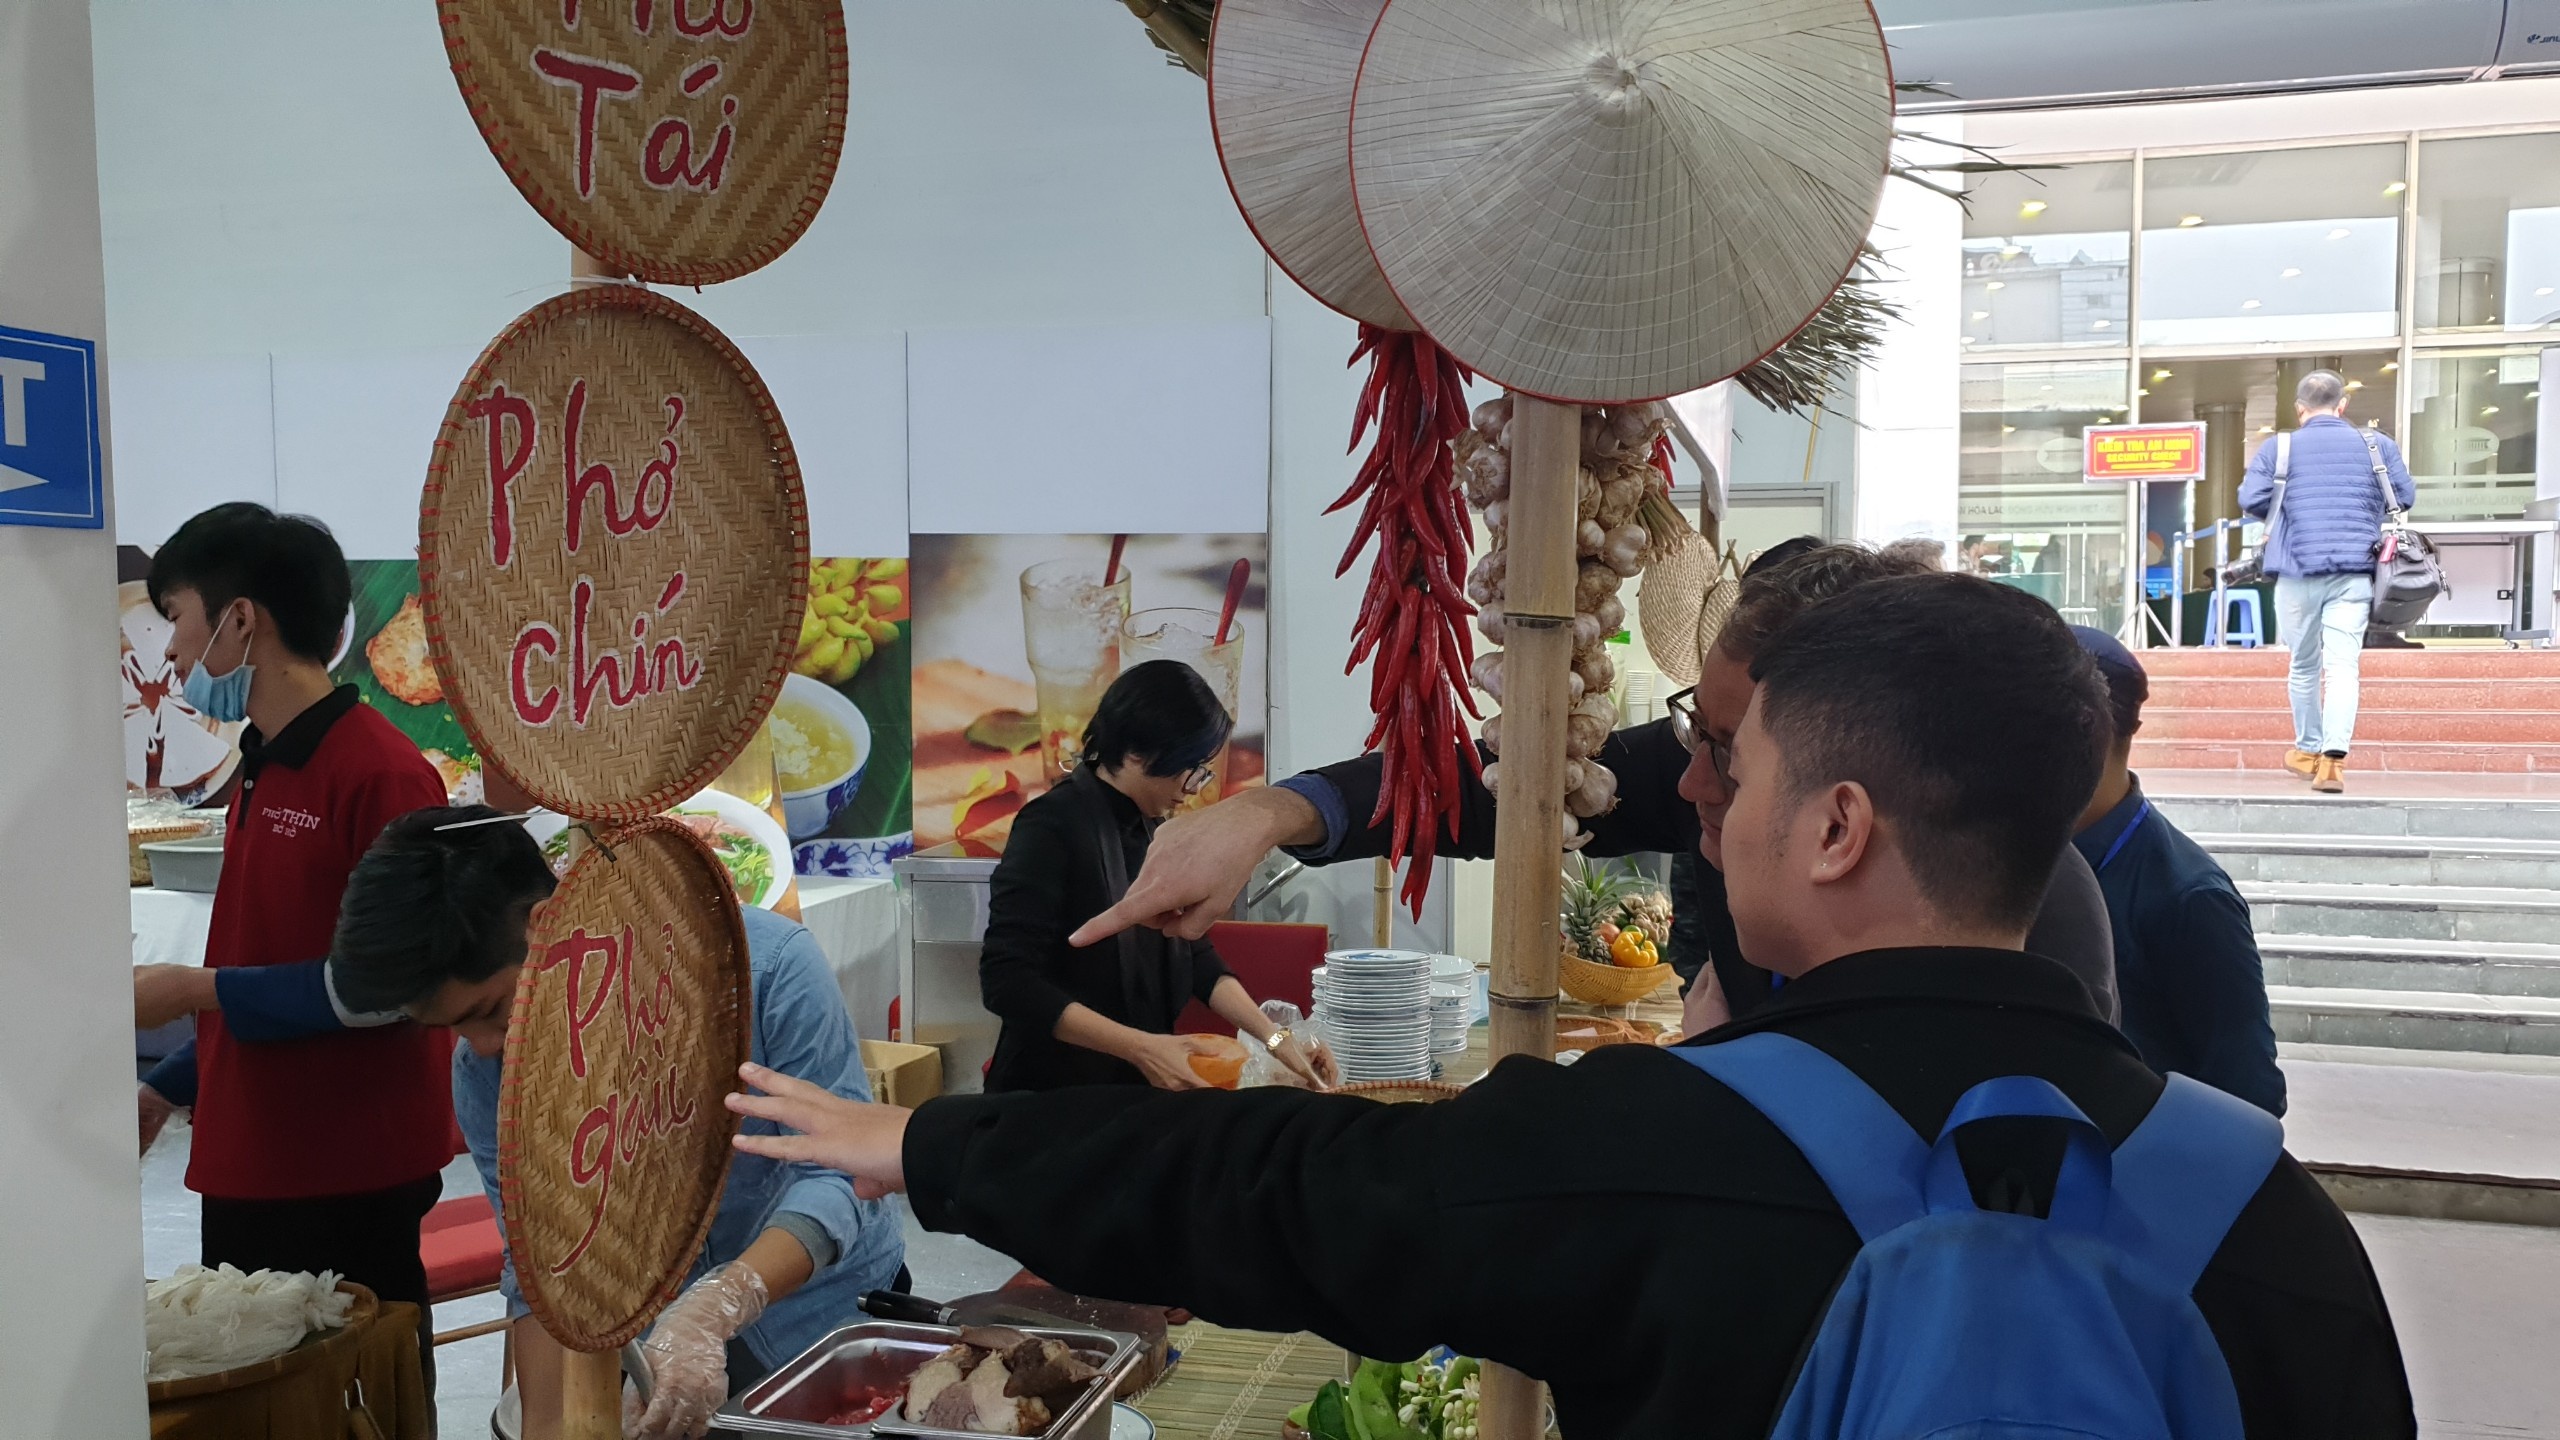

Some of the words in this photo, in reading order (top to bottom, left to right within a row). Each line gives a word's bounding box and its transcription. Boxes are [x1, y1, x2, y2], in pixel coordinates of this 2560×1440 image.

[531, 47, 738, 197] Tái
[465, 378, 685, 569] Phở
[2106, 452, 2149, 462] SECURITY
[2151, 451, 2181, 461] CHECK
[2126, 440, 2145, 451] TRA
[2147, 438, 2162, 451] AN
[282, 808, 320, 830] THÌN
[541, 922, 674, 1078] Phở
